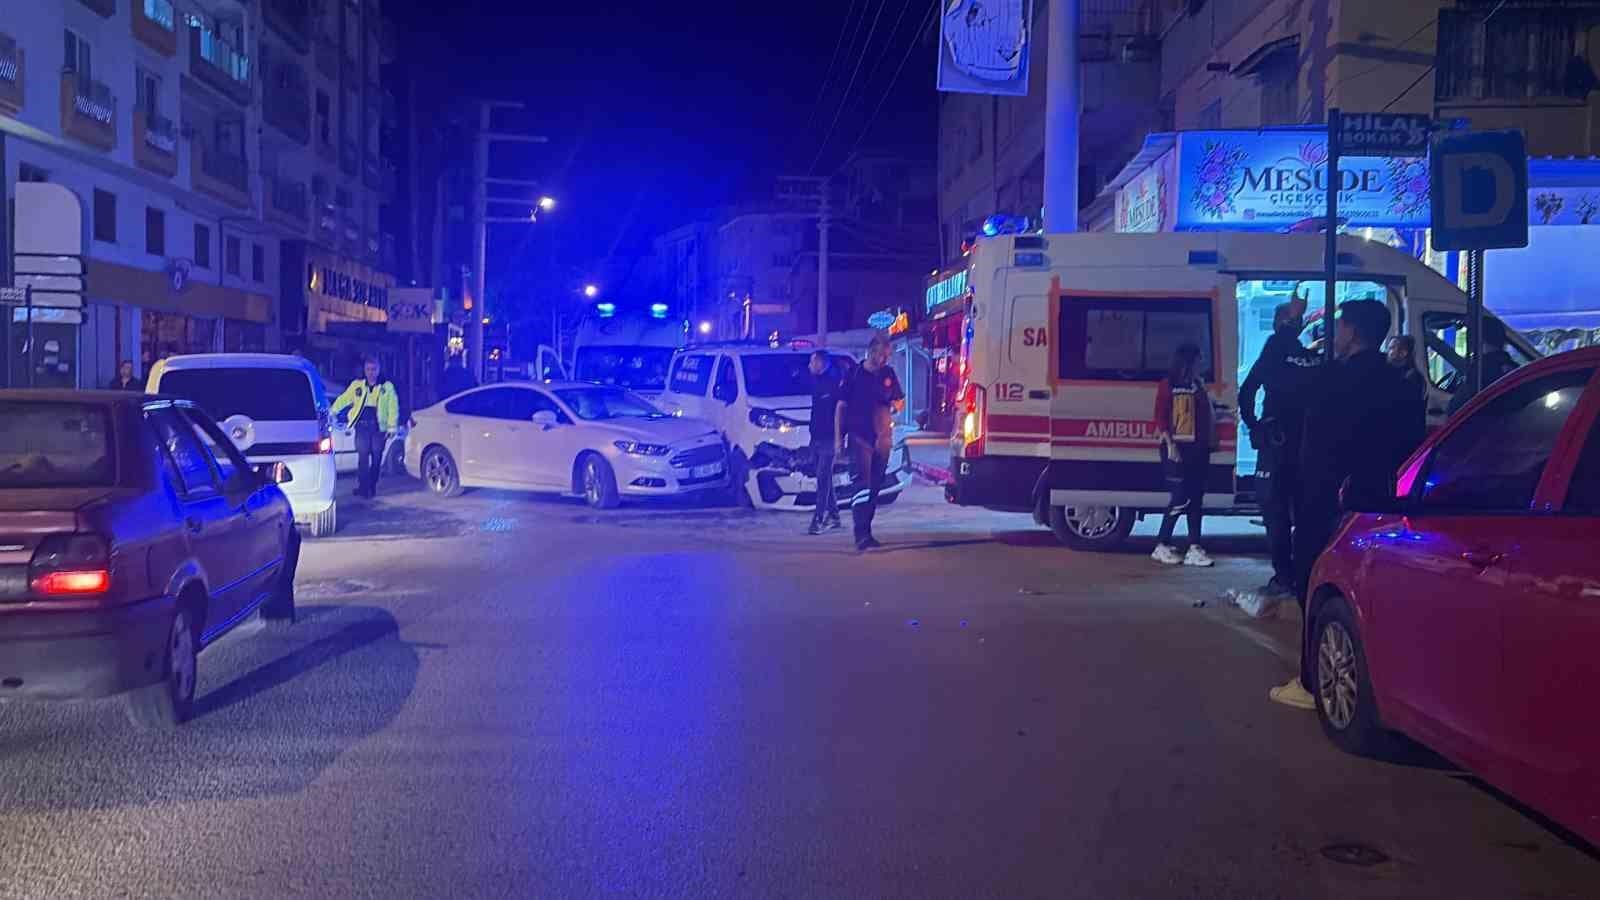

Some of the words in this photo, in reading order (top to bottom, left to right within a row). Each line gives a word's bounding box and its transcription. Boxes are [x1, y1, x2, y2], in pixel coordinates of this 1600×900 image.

[1234, 166, 1387, 199] MESUDE
[1441, 153, 1516, 230] D
[995, 383, 1025, 402] 112
